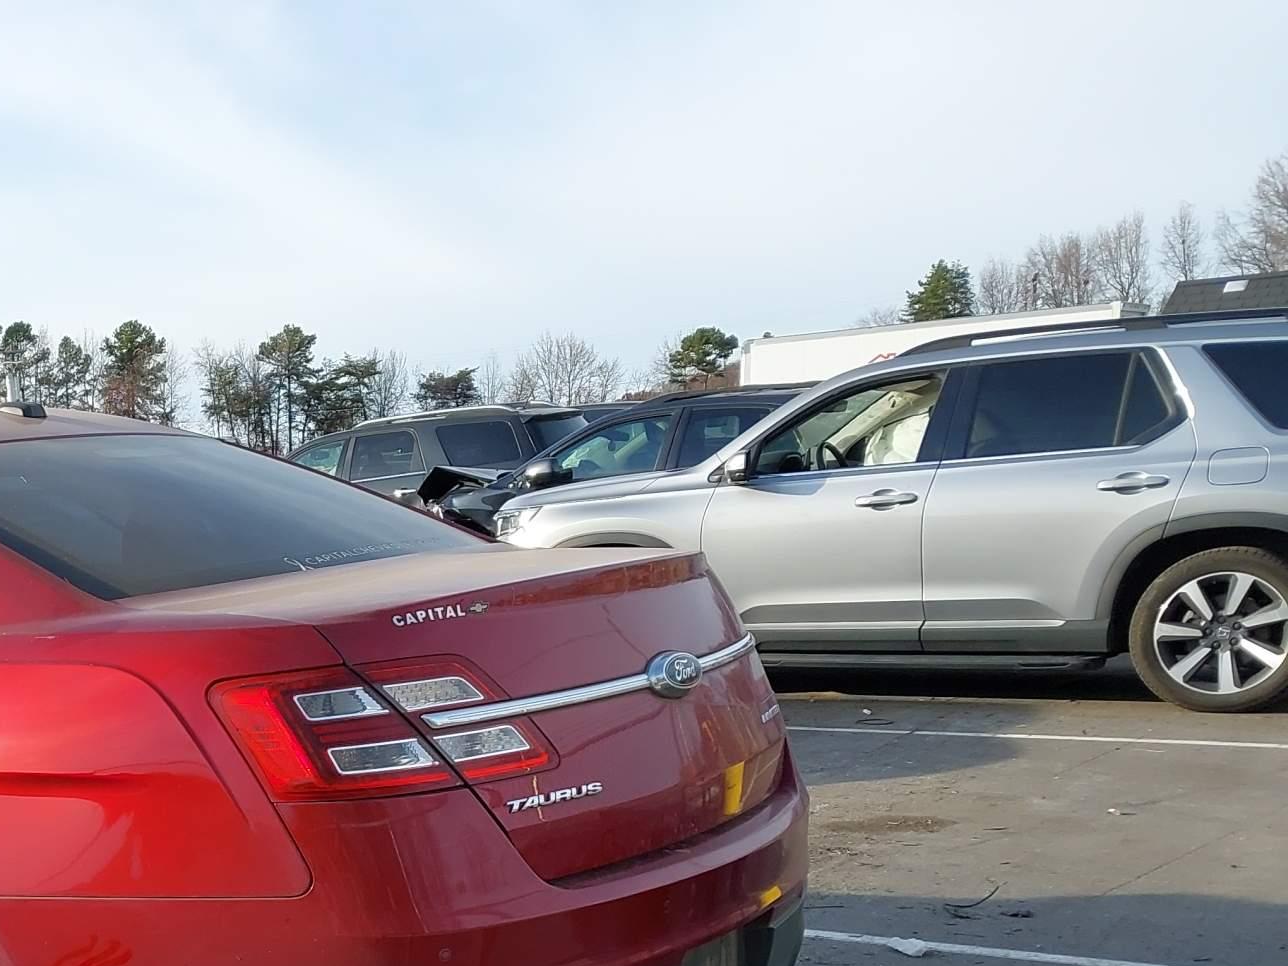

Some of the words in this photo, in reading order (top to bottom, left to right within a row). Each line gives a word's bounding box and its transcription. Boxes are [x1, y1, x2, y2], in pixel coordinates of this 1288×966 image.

[392, 604, 466, 627] CAPITAL
[674, 658, 697, 681] Ford
[506, 782, 603, 813] TAURUS
